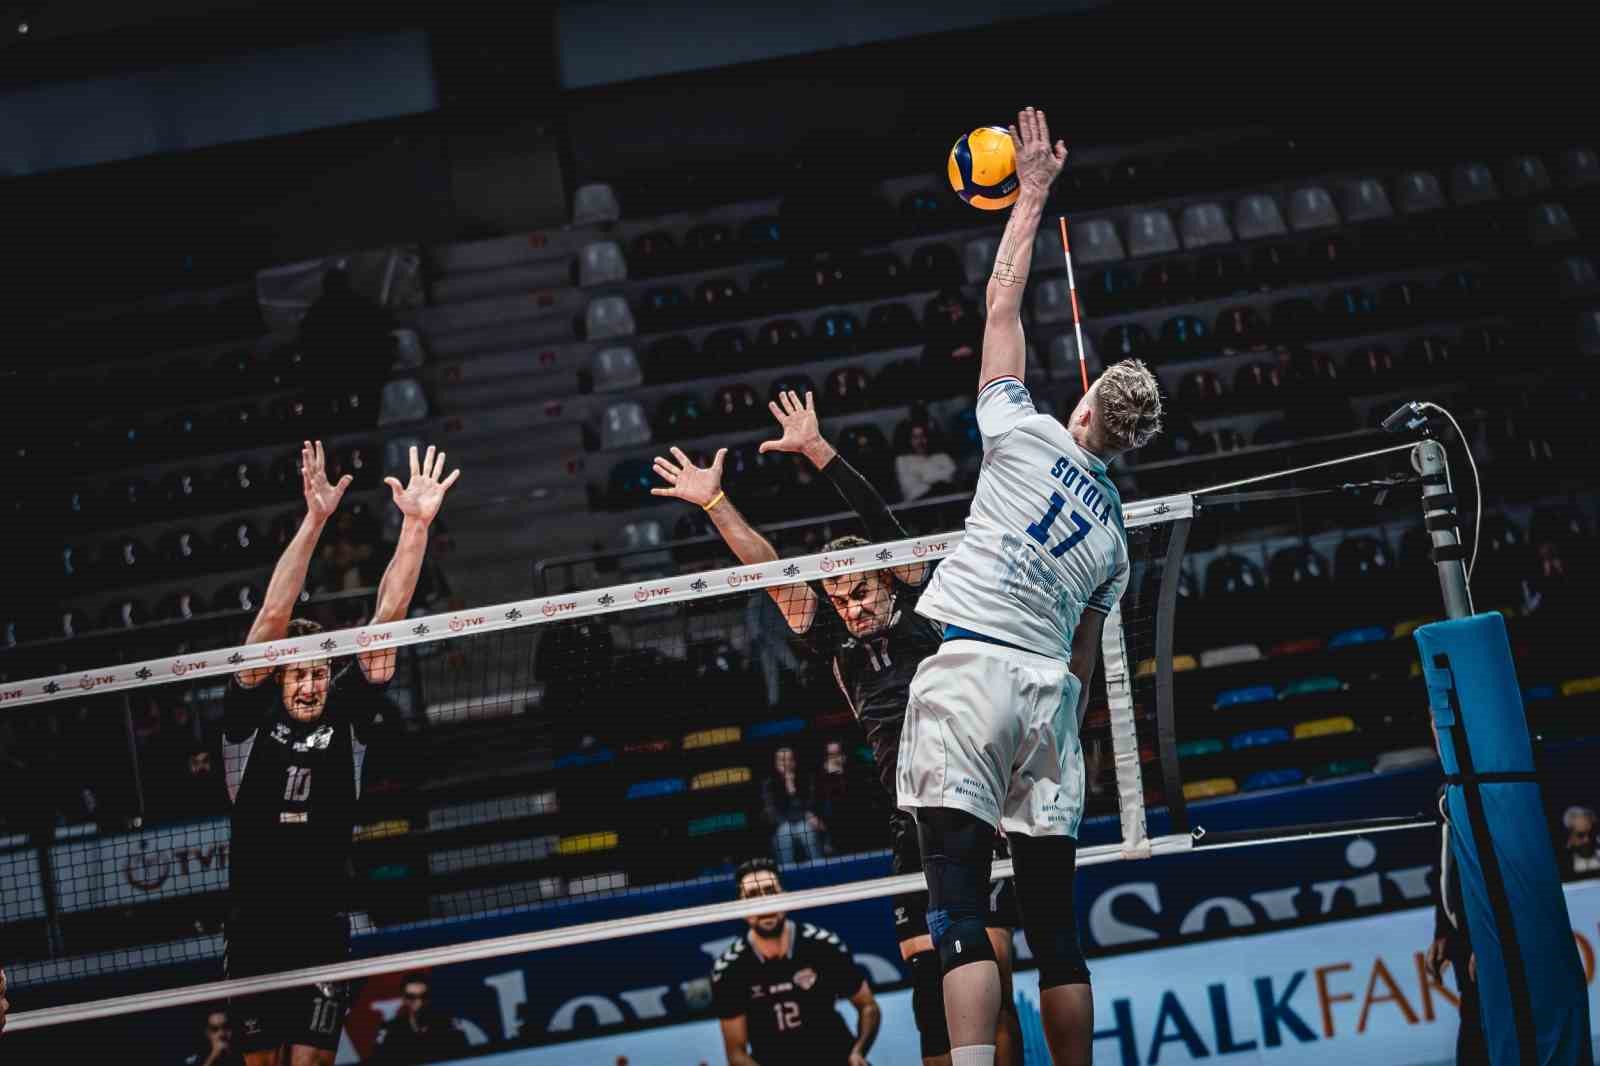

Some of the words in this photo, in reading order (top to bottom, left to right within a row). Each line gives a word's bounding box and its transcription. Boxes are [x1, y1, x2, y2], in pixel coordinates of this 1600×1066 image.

[1025, 490, 1093, 559] 17
[283, 765, 312, 801] 10
[309, 997, 338, 1034] 10
[773, 1001, 801, 1031] 12
